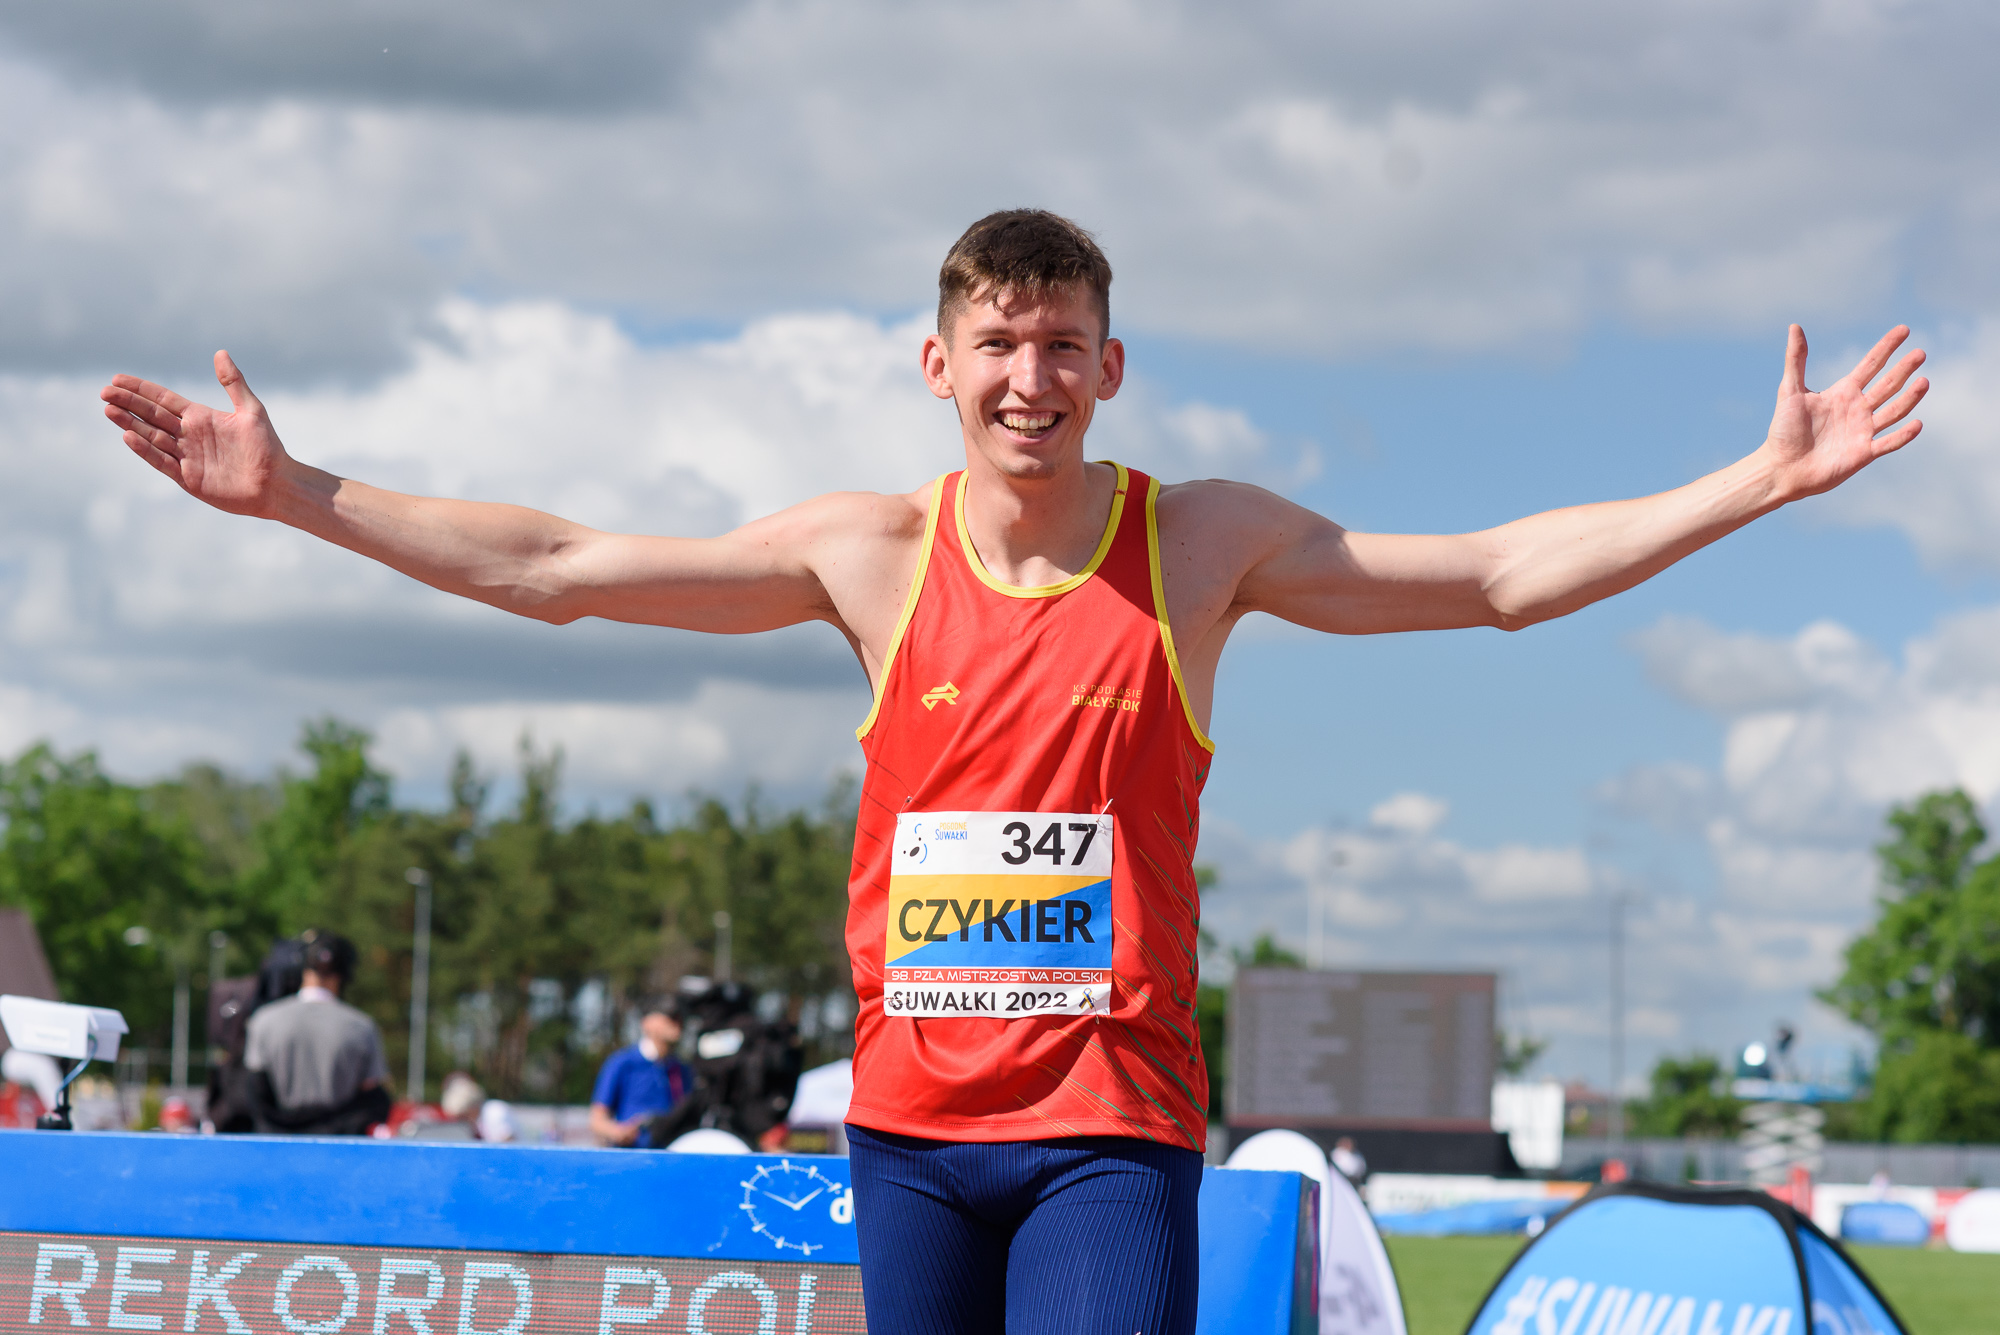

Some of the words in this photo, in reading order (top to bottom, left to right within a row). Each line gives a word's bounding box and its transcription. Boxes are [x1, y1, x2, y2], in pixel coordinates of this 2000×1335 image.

[1073, 684, 1087, 693] KS
[1090, 685, 1142, 699] PODLASIE
[1071, 695, 1141, 713] BIAŁYSTOK
[939, 821, 968, 831] POGODNE
[1001, 821, 1098, 866] 347
[898, 898, 1096, 944] CZYKIER
[891, 970, 911, 981] 98.
[914, 970, 945, 981] PZLA
[947, 970, 1050, 982] MISTRZOSTWA
[1052, 971, 1103, 983] POLSKI
[892, 990, 996, 1011] SUWAŁKI
[1004, 991, 1068, 1012] 2022
[27, 1242, 534, 1335] REKORD
